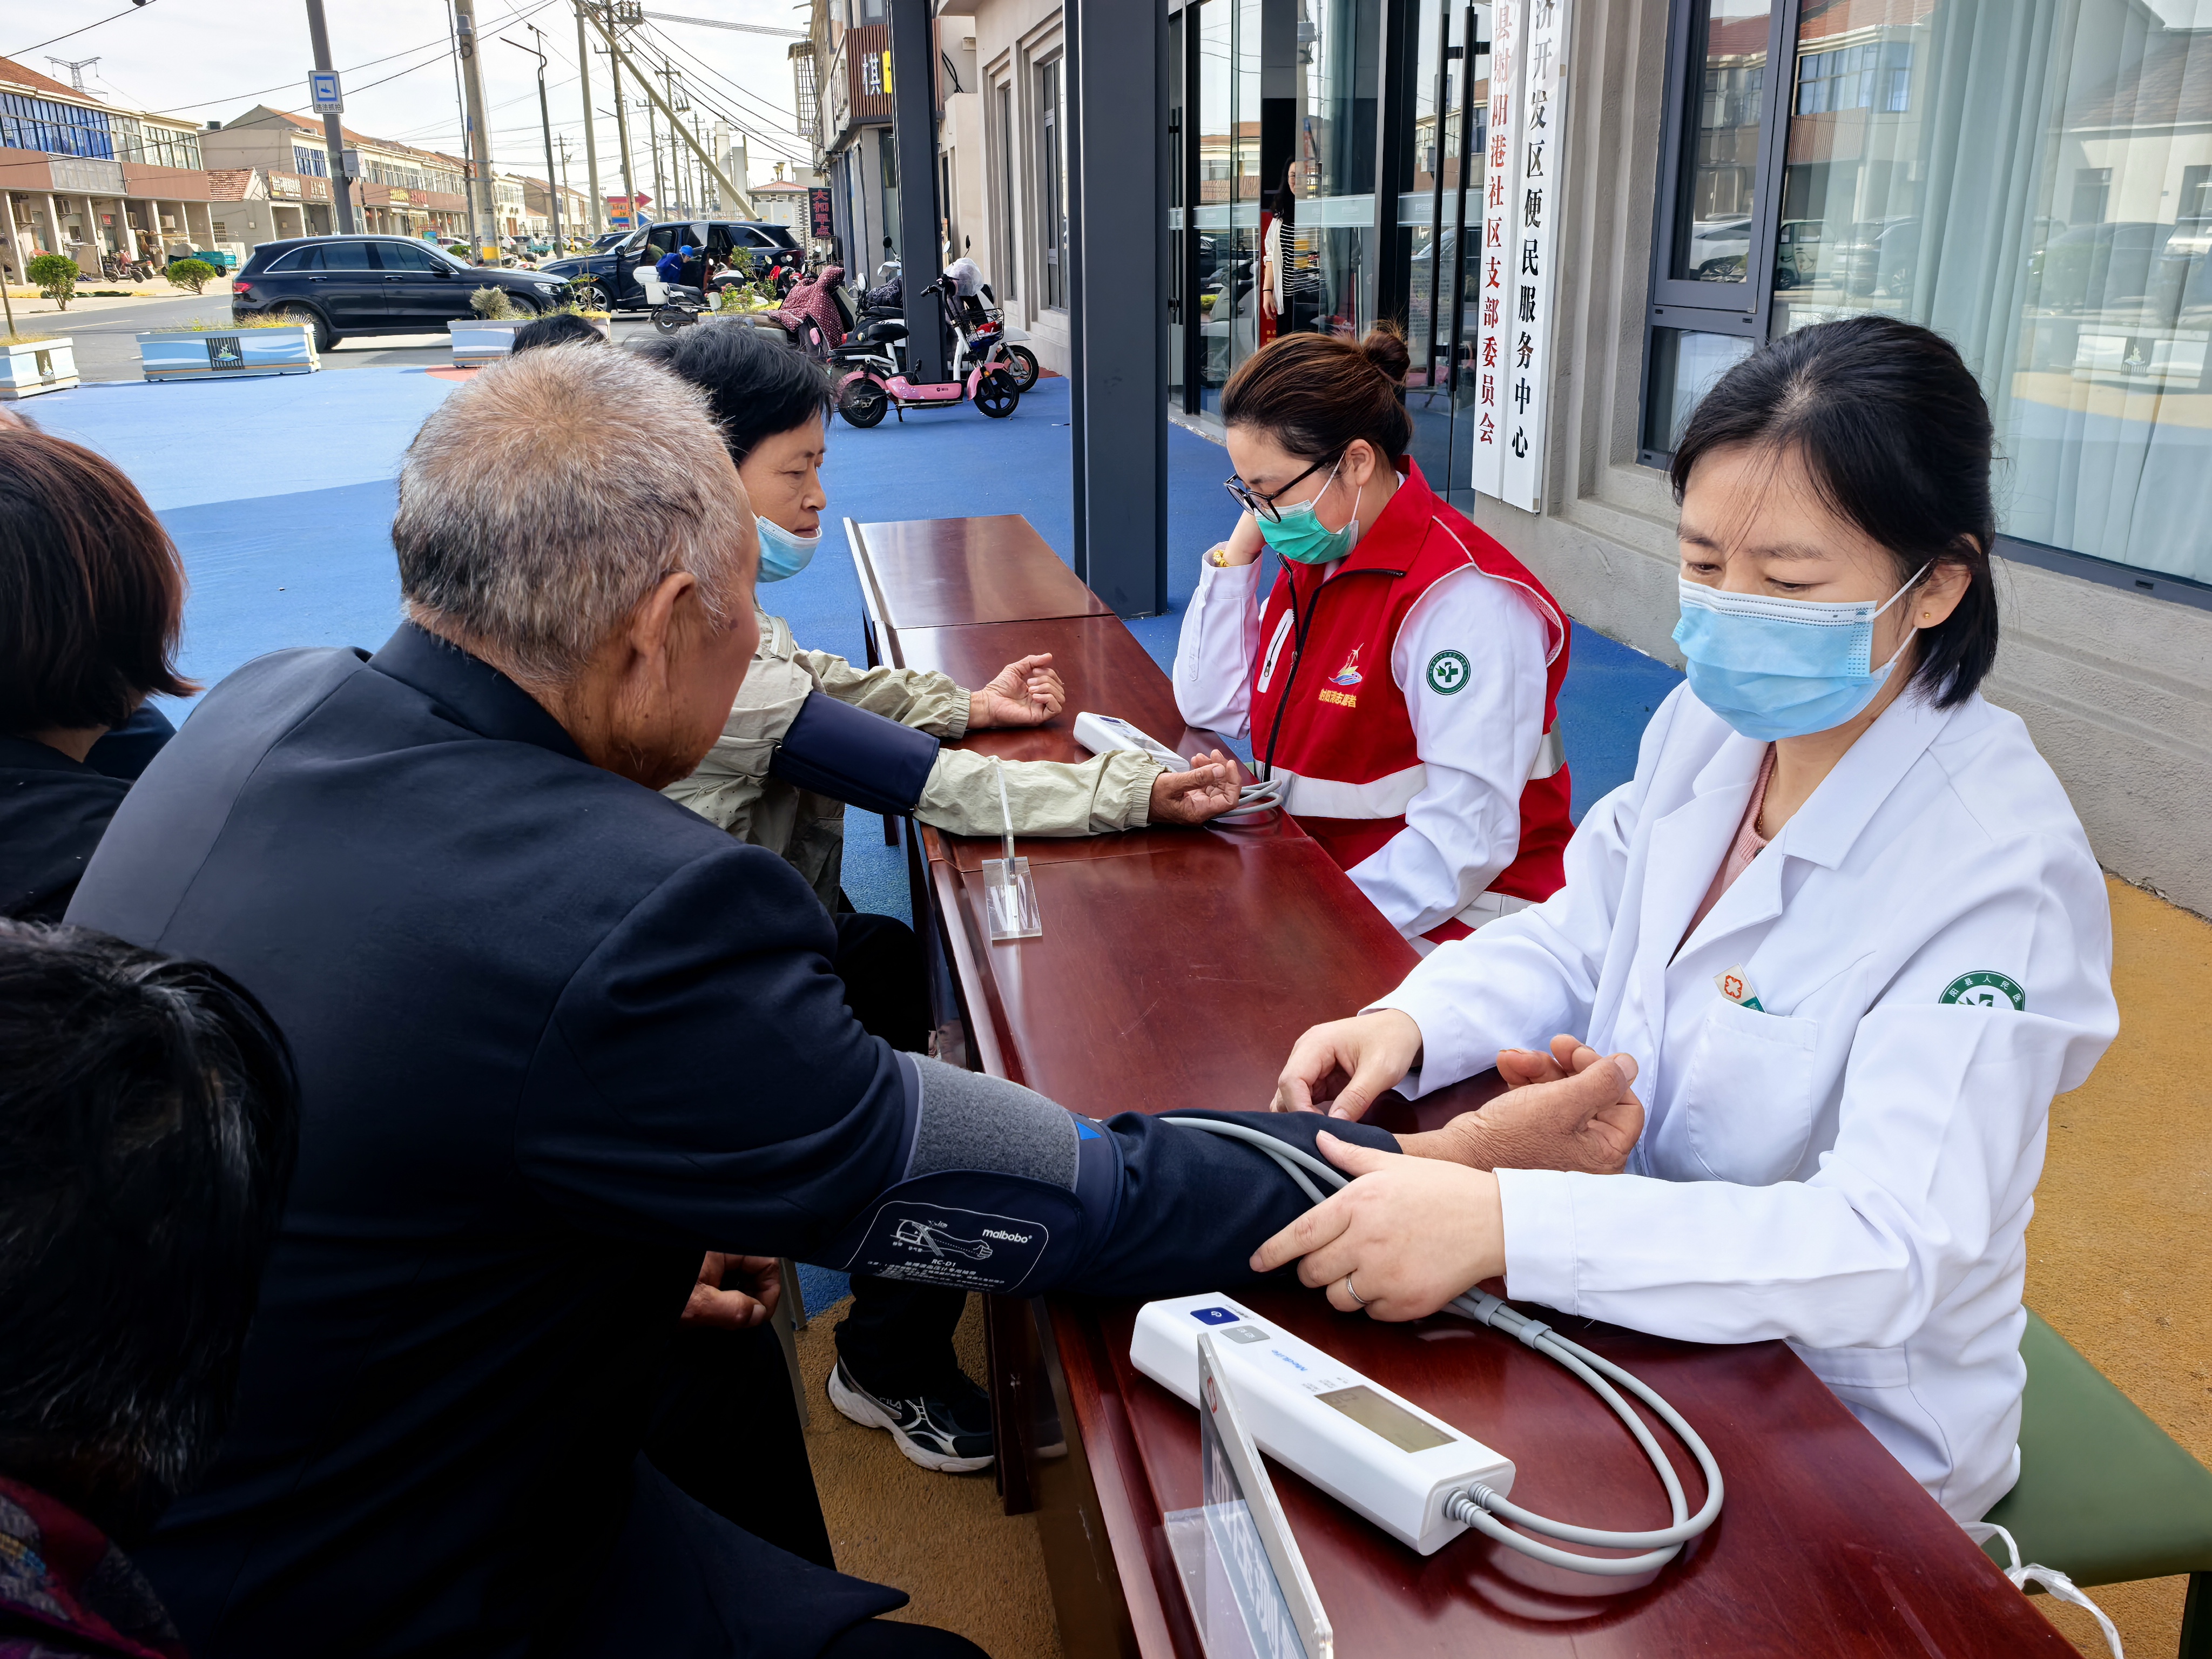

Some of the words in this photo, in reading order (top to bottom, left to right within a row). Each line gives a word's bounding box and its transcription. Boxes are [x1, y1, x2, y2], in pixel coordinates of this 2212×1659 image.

[315, 103, 341, 111] 违法抓拍
[812, 189, 831, 236] 大扣早点
[931, 1259, 956, 1267] RC-D1
